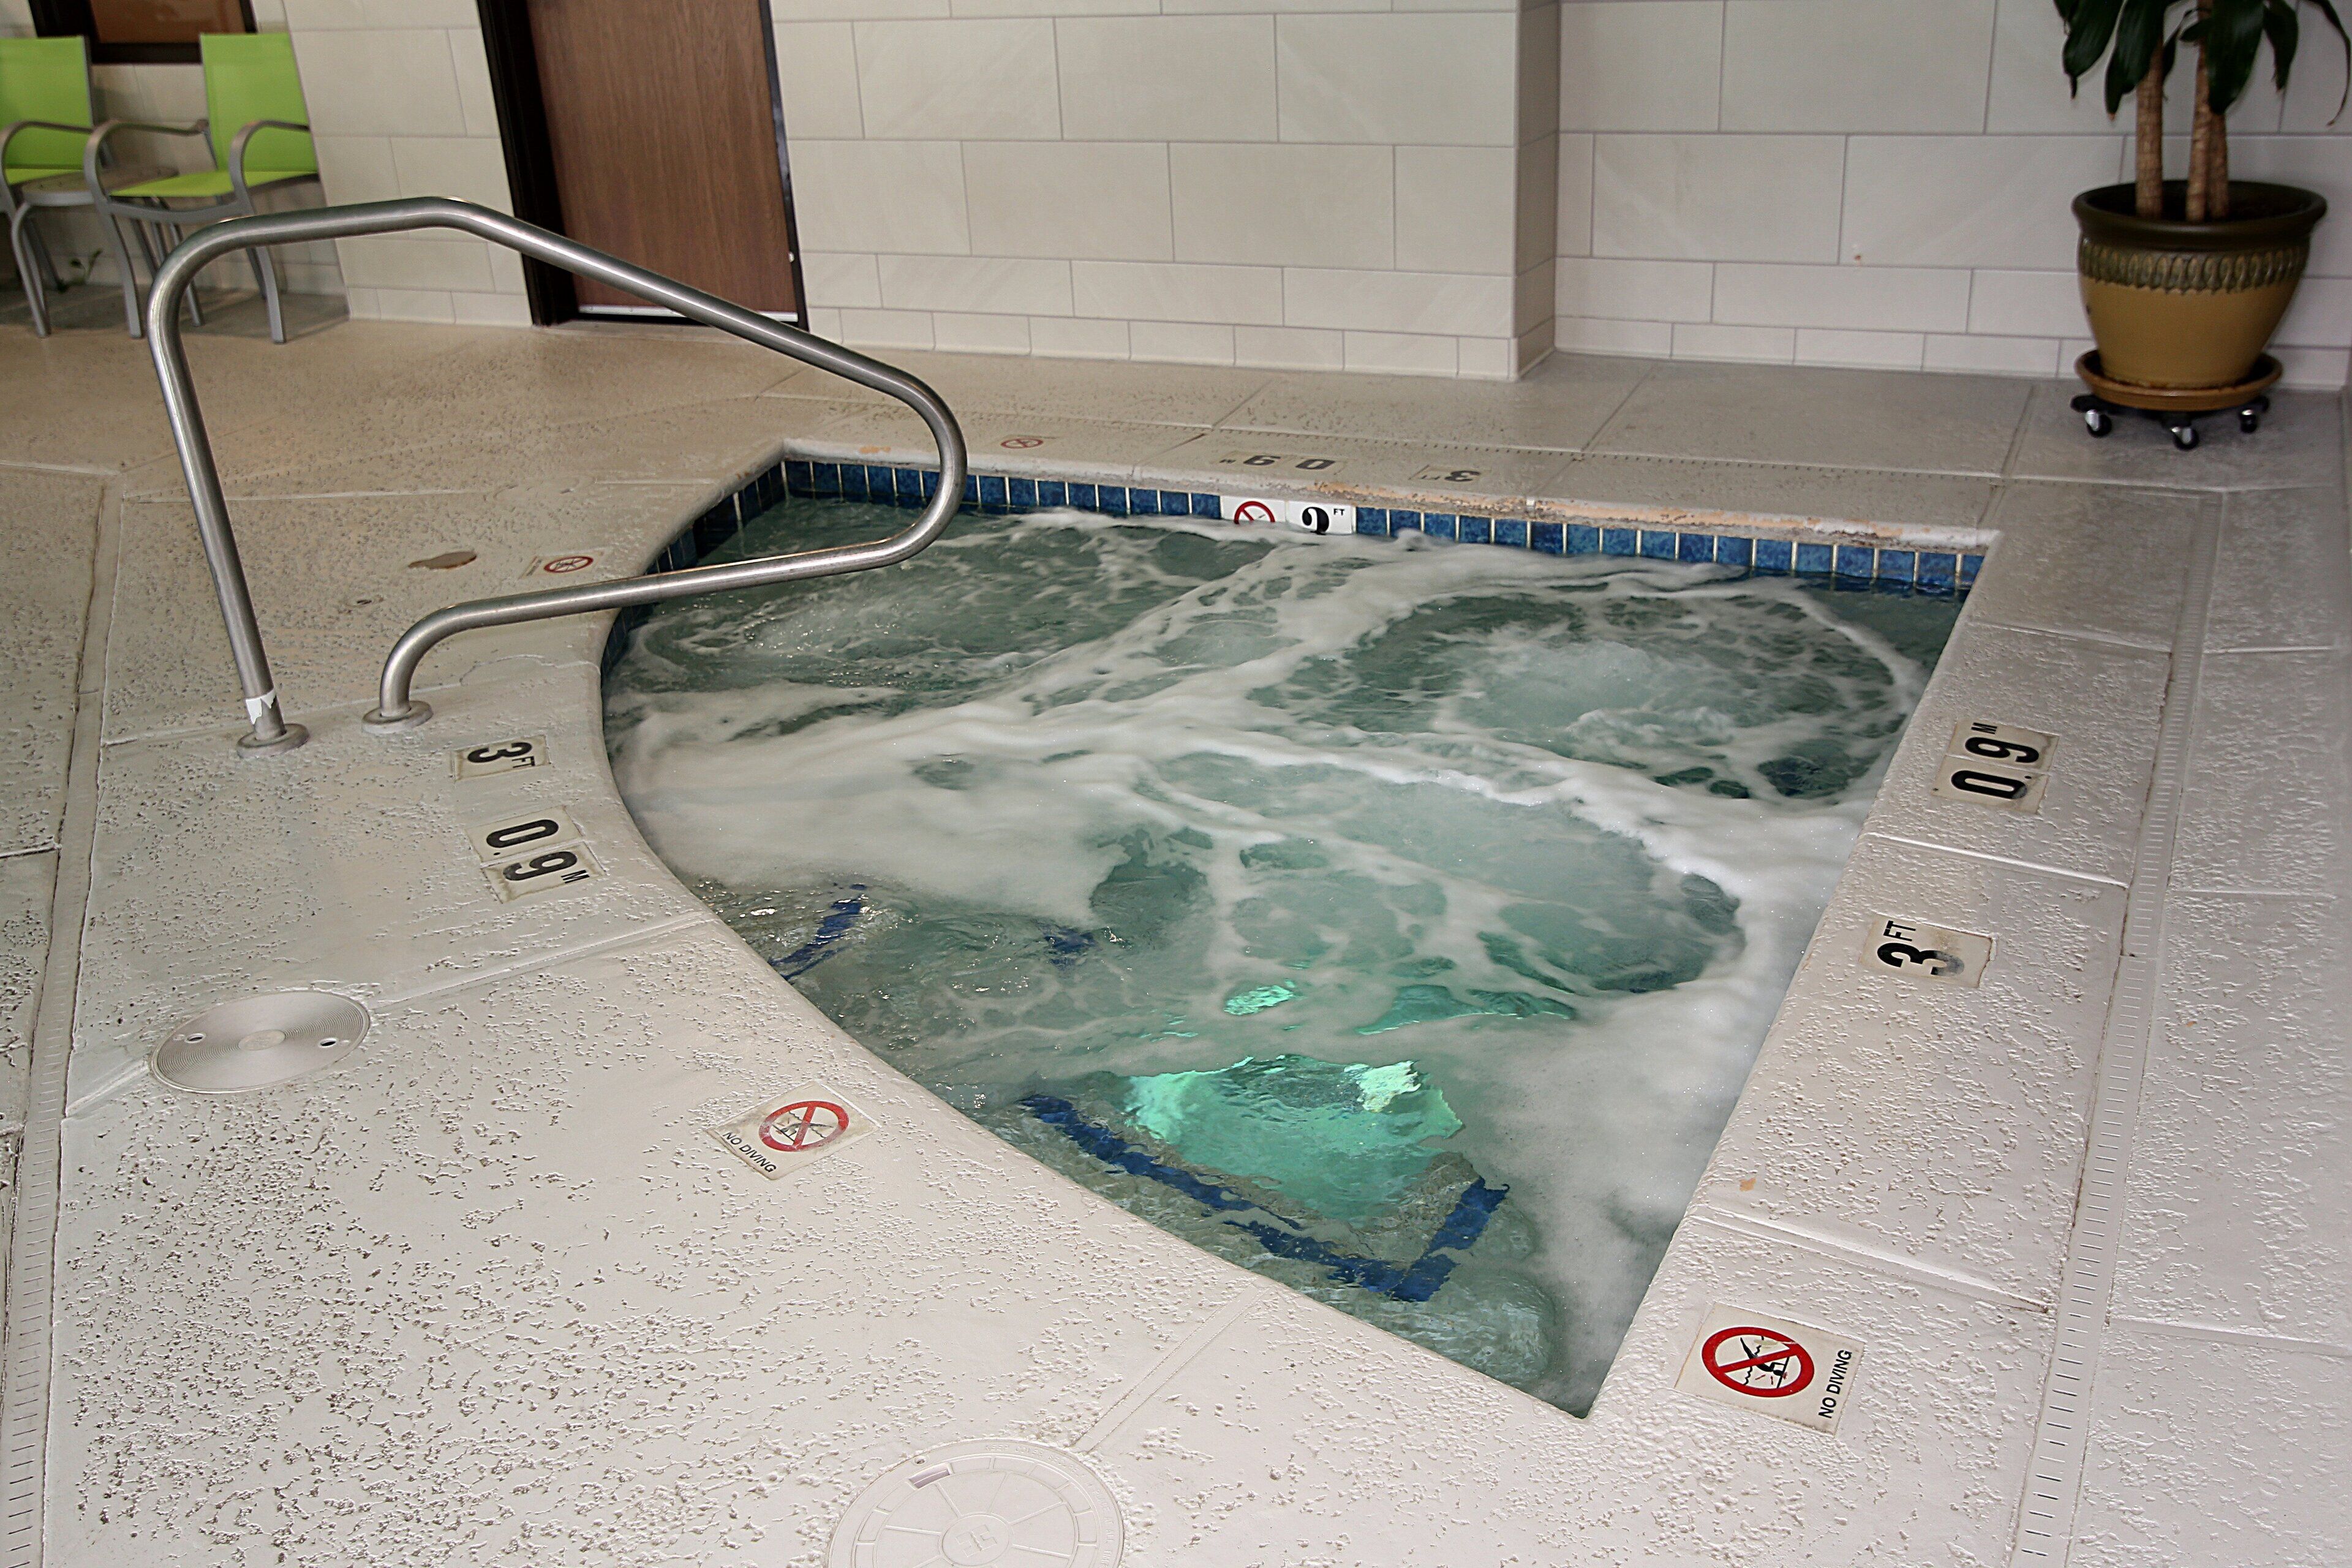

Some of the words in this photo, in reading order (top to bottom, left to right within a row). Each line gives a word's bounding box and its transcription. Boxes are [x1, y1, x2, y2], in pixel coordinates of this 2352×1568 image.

[1444, 470, 1481, 482] 3
[1970, 722, 1997, 734] M
[467, 742, 532, 763] 3
[511, 756, 535, 768] FT
[560, 870, 590, 884] M
[1883, 920, 1916, 941] FT
[1877, 942, 1964, 977] 3
[723, 1132, 742, 1145] NO
[739, 1144, 777, 1173] DIVING
[1826, 1349, 1852, 1395] DIVING
[1818, 1397, 1836, 1419] NO
